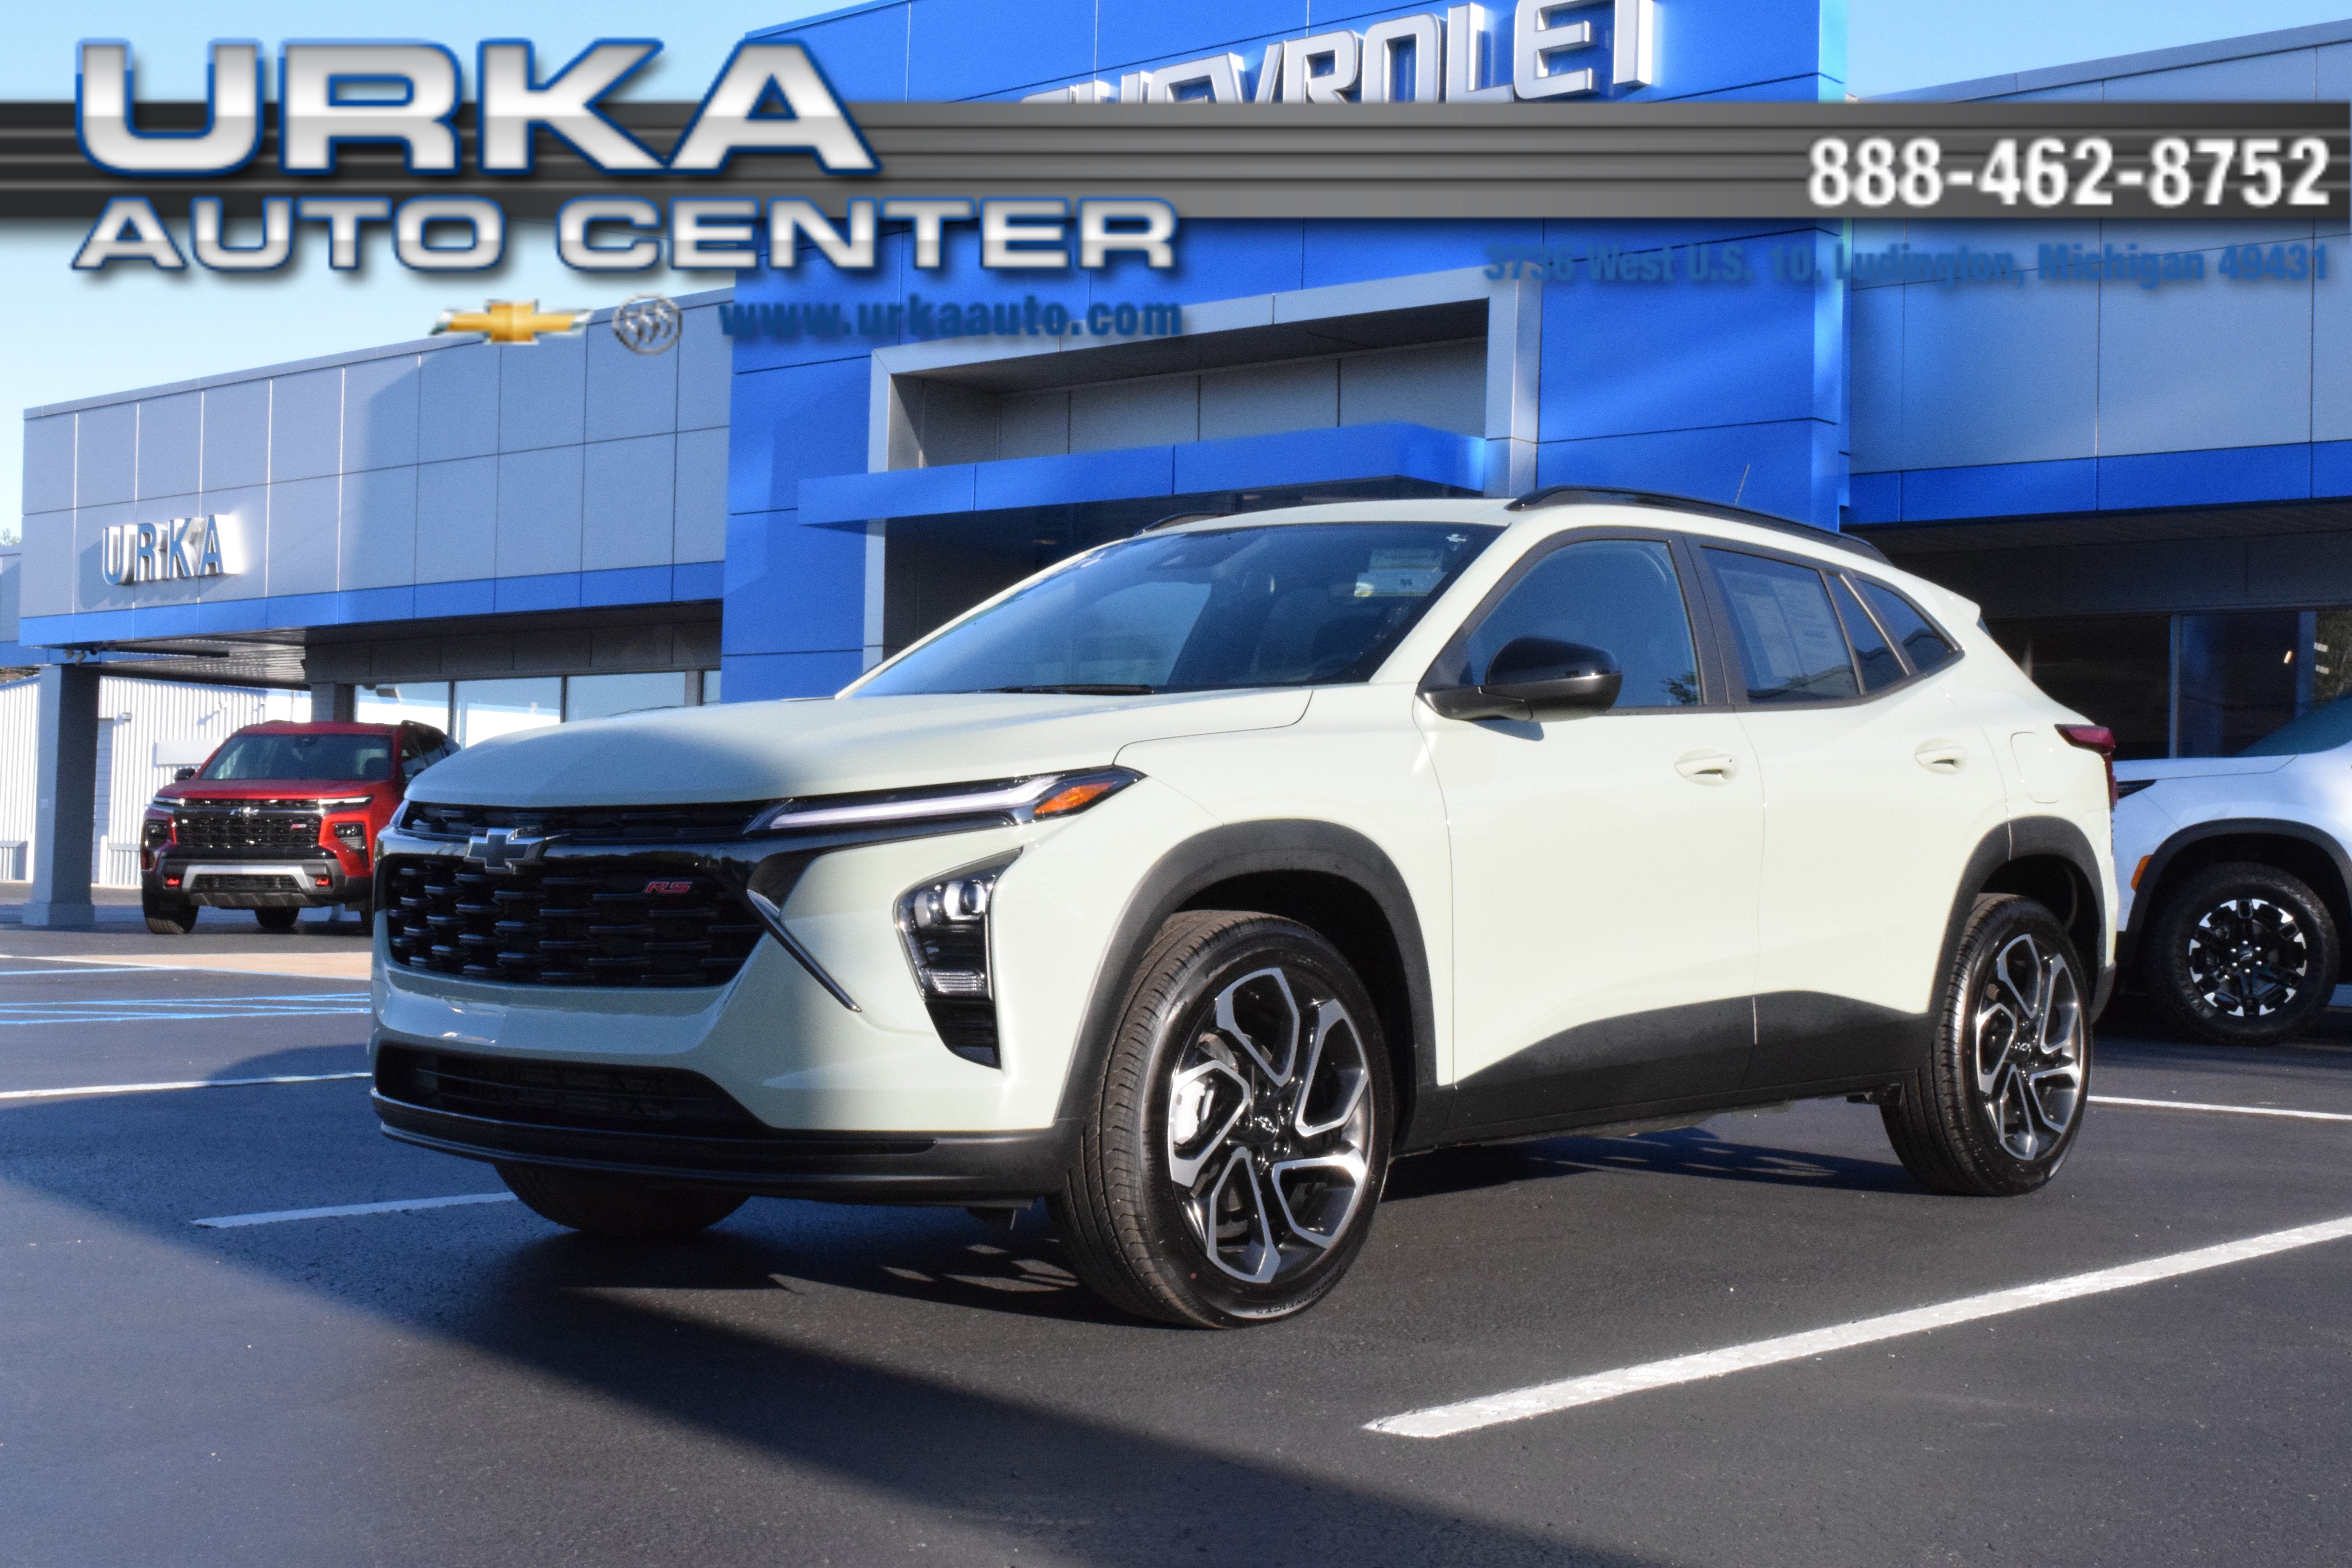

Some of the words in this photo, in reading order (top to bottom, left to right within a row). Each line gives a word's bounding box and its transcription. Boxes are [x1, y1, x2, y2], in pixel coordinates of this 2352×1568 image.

[1020, 0, 1653, 103] VROLE
[102, 514, 227, 586] URKA
[645, 881, 693, 893] RS
